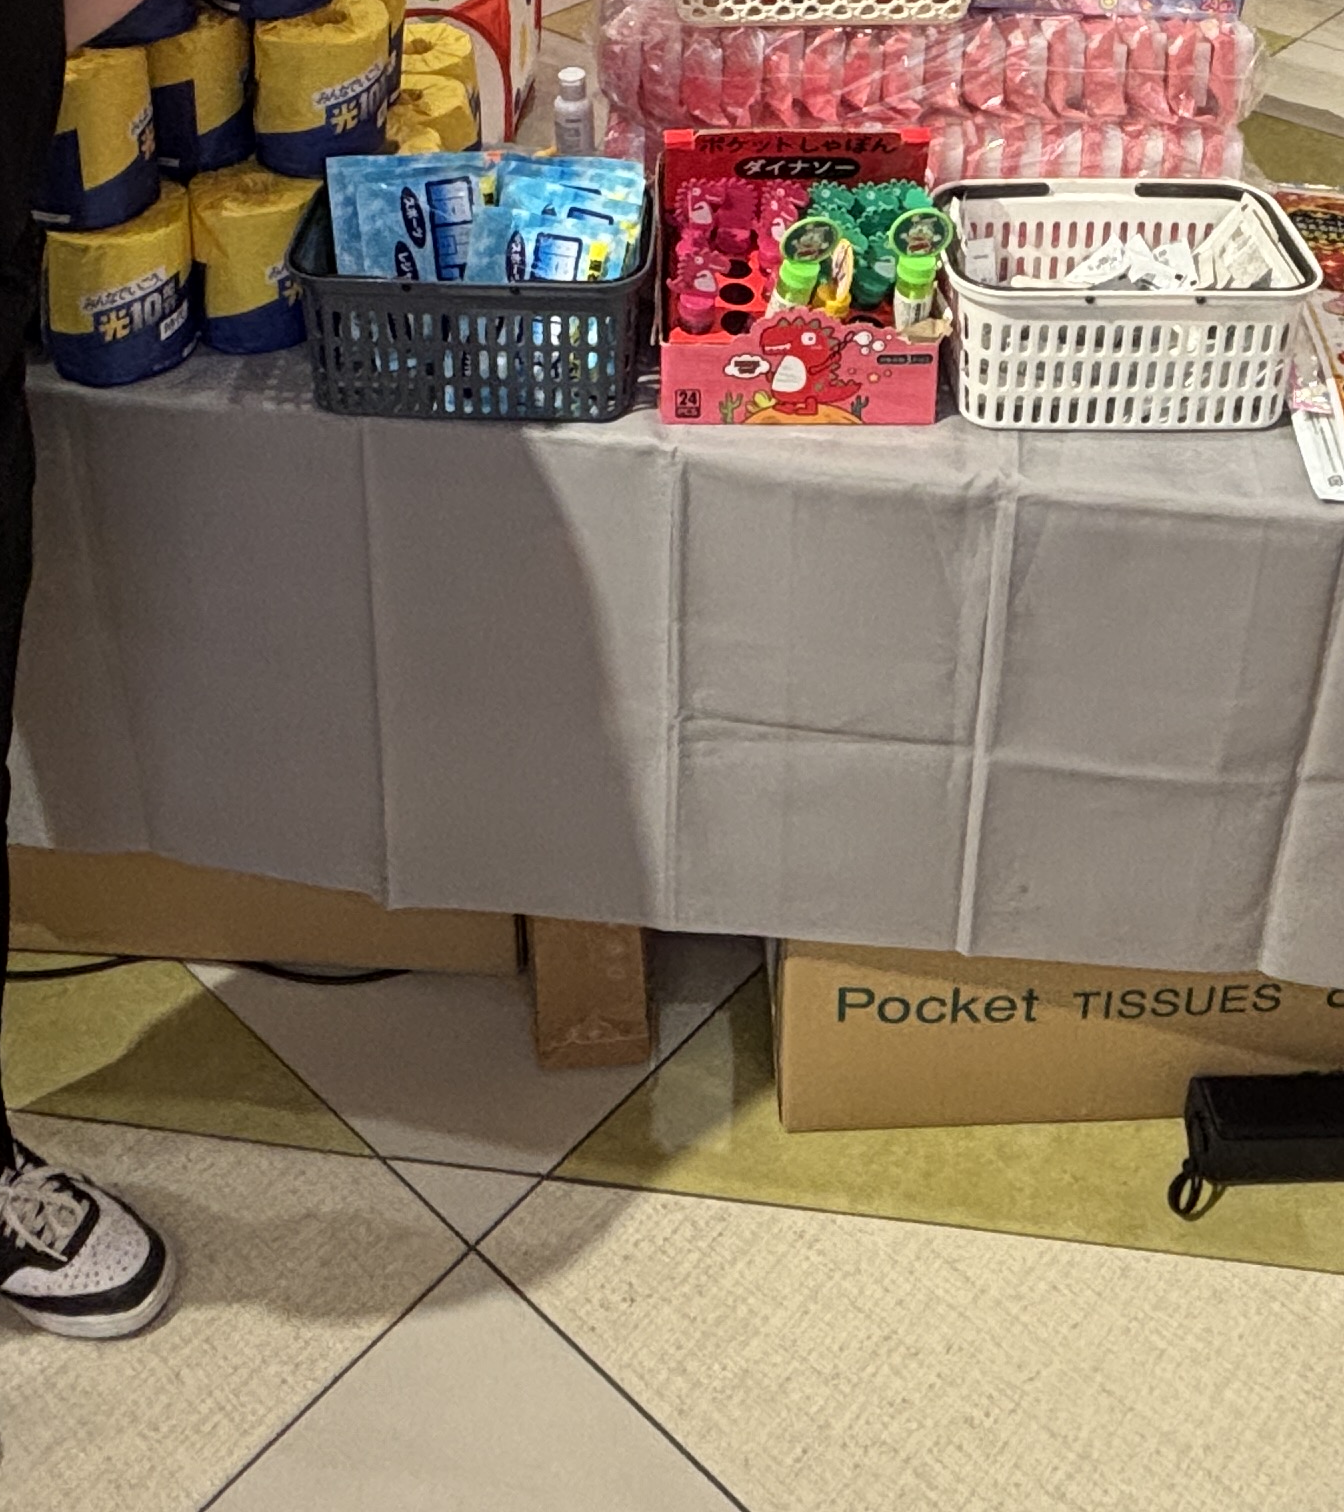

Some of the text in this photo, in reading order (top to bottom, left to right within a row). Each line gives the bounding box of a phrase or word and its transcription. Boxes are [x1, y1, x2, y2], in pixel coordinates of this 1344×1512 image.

[699, 135, 897, 154] ポケットしゃぼん
[743, 158, 856, 176] ダイナソー
[678, 391, 698, 405] 24
[836, 987, 1039, 1025] Pocket
[1073, 983, 1281, 1020] TISSUES
